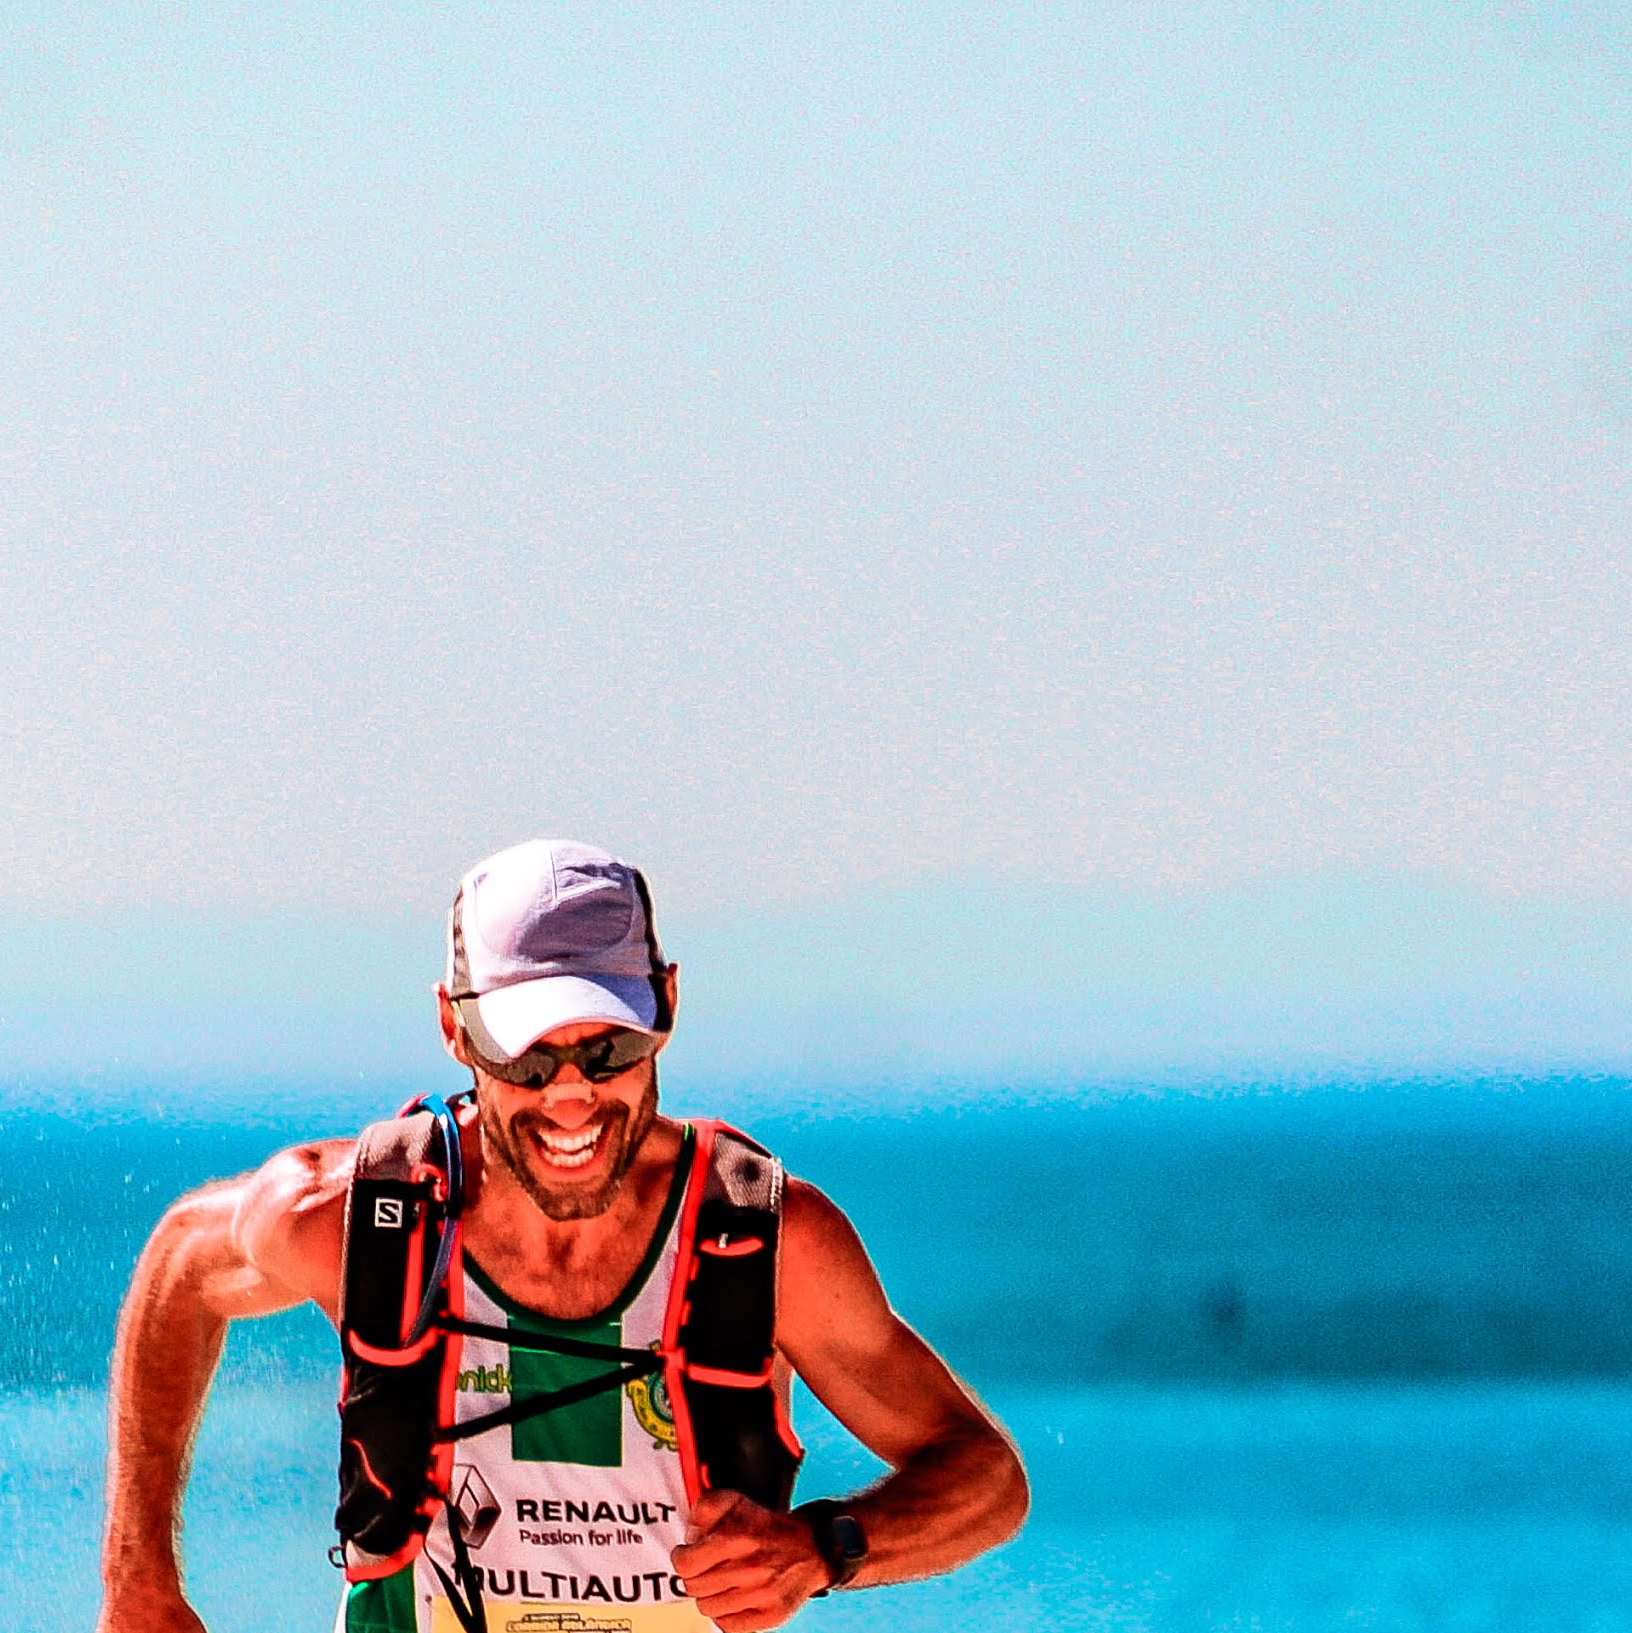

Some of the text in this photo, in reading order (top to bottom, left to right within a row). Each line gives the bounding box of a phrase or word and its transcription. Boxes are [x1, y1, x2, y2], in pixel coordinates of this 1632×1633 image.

[516, 1499, 677, 1525] RENAULT
[519, 1528, 644, 1546] Passion for life
